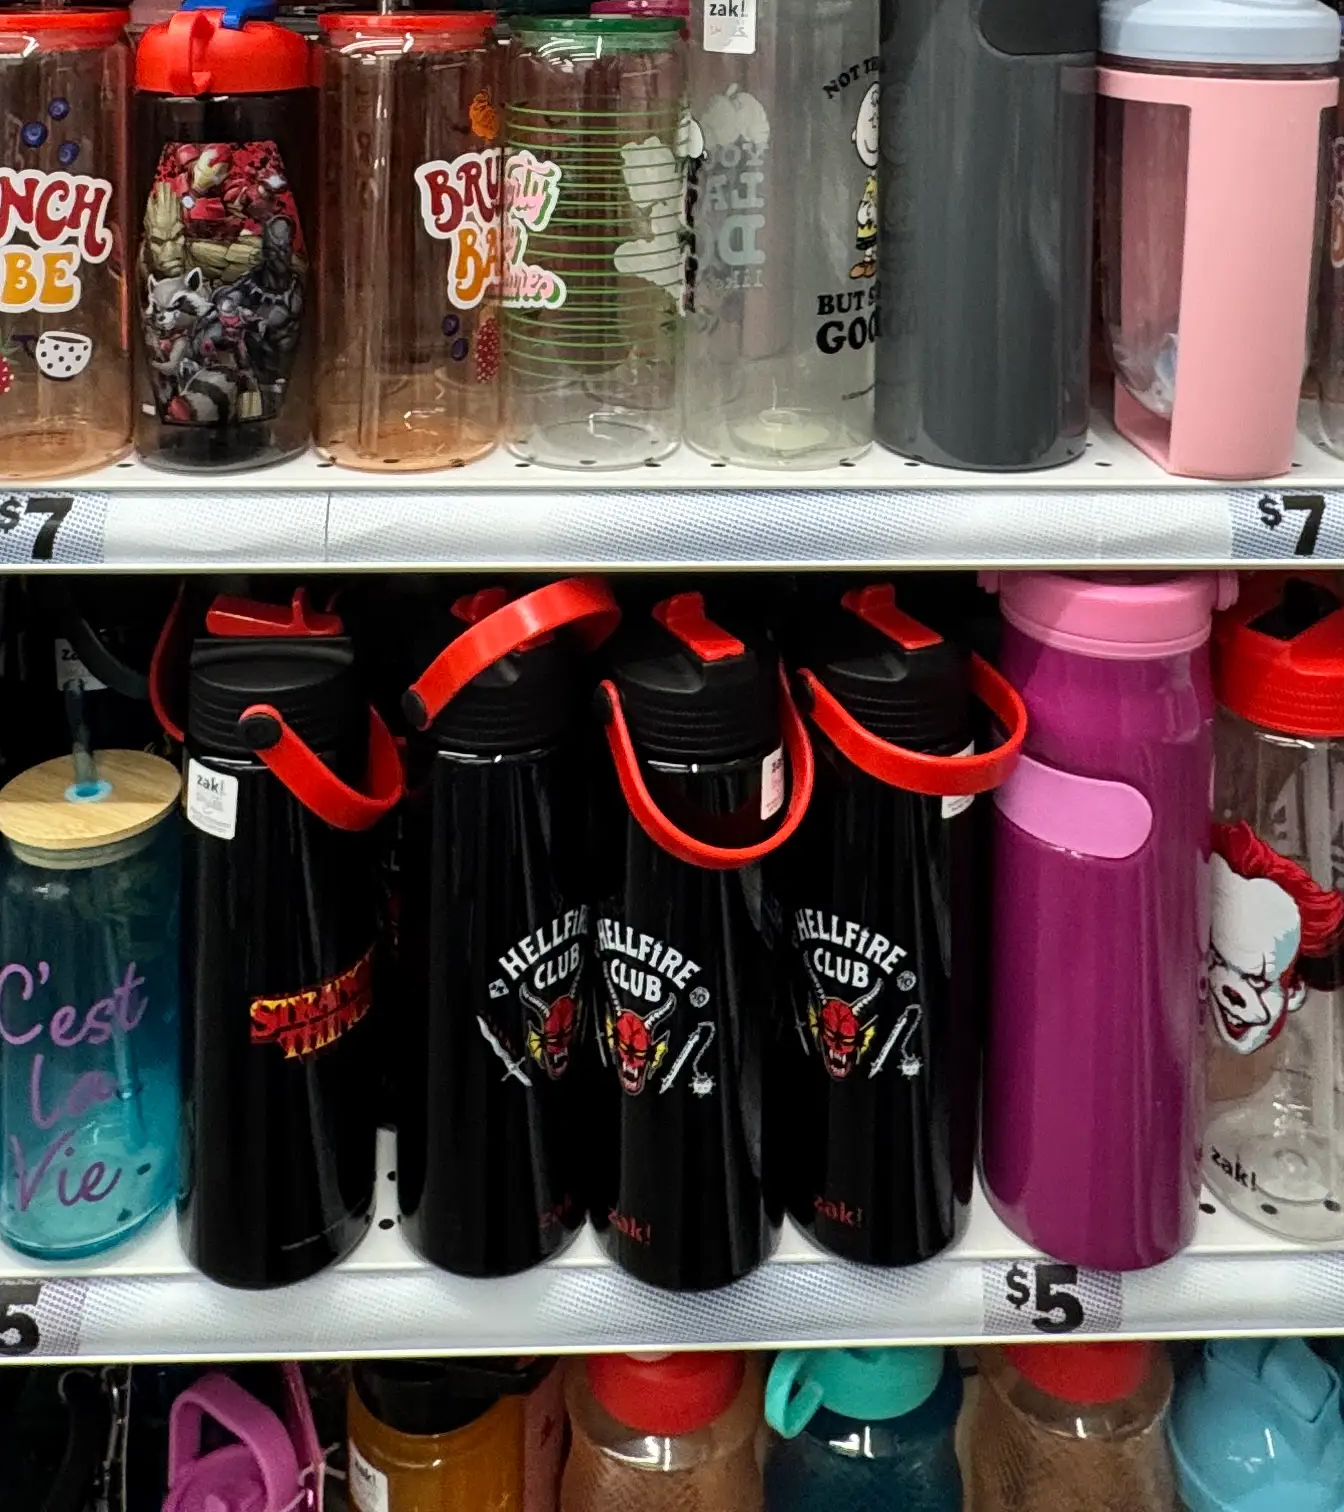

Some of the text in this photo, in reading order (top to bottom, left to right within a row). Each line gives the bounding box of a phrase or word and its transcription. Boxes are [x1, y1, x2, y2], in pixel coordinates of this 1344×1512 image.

[822, 64, 860, 100] NOT
[816, 290, 866, 316] BUT
[1258, 494, 1327, 556] $7
[196, 774, 226, 794] zak!
[596, 917, 702, 990] HELLFIRE
[795, 908, 908, 976] HELLFIRE
[533, 945, 580, 989] CLUB
[610, 958, 662, 1003] CLUB
[812, 948, 870, 988] CLUB
[10, 1129, 123, 1213] Vie
[1210, 1145, 1257, 1192] zak!
[1005, 1262, 1085, 1334] $5
